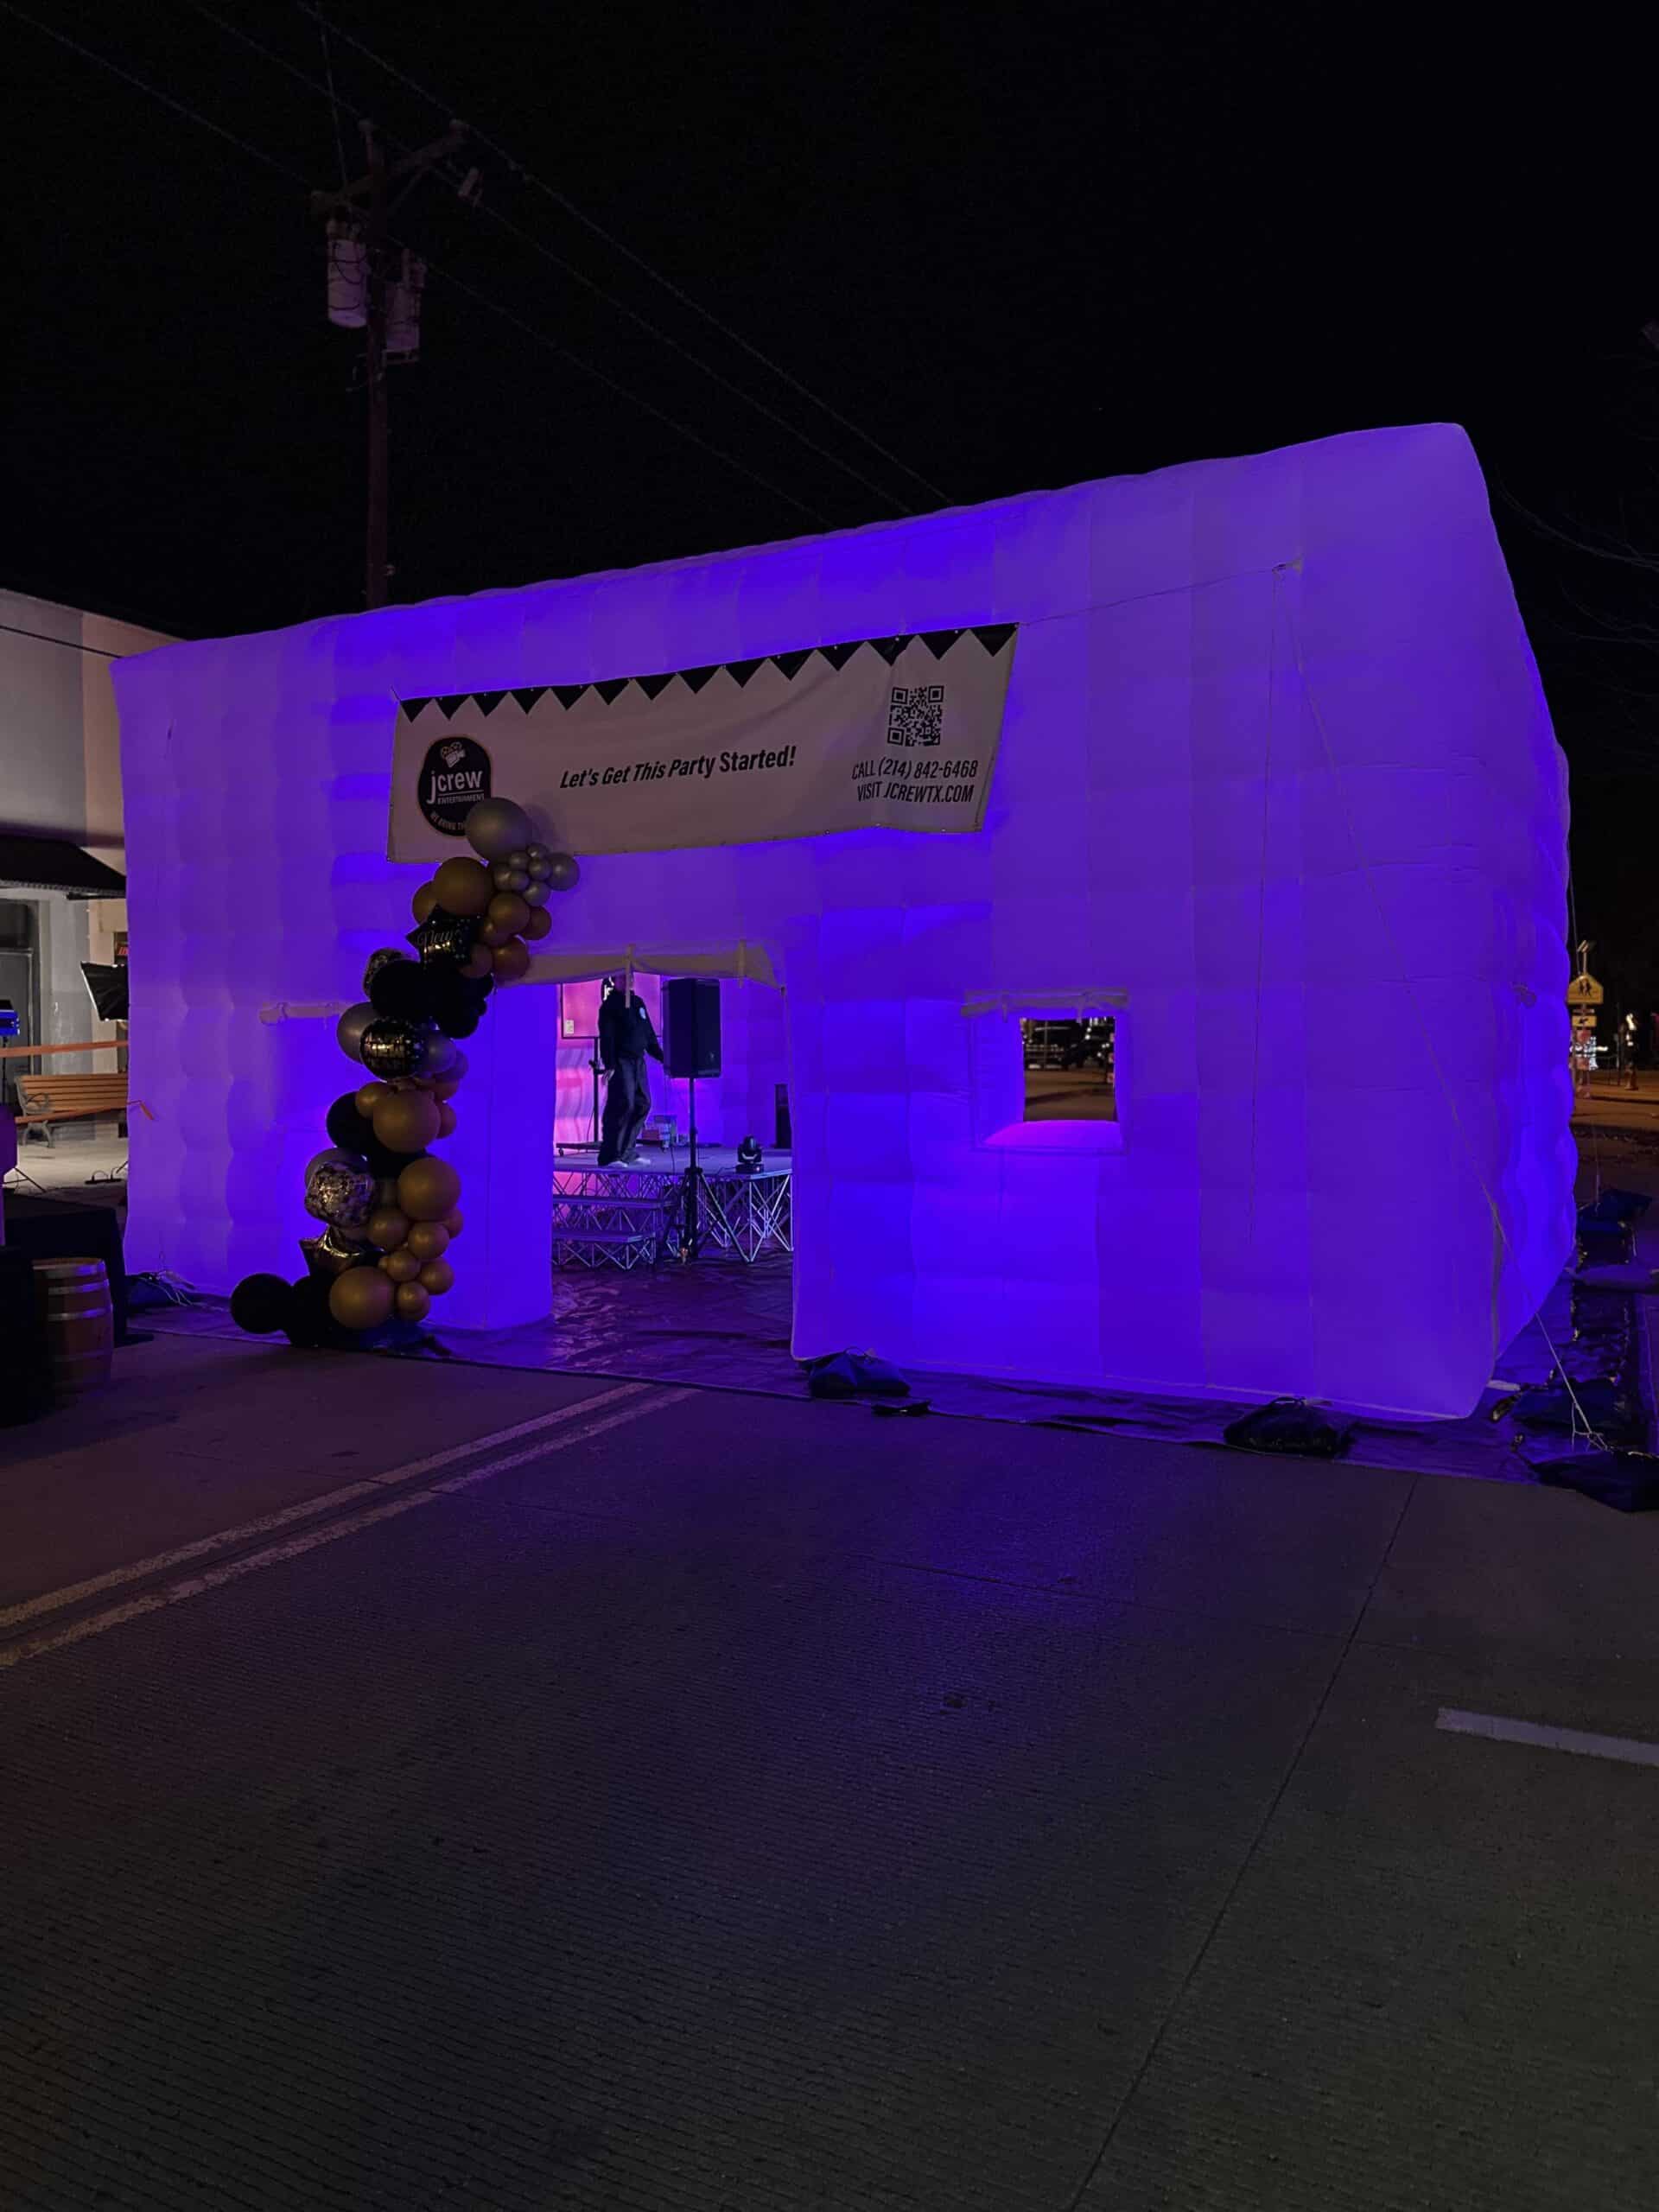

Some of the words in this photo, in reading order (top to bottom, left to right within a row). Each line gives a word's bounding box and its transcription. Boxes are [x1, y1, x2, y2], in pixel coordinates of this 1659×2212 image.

[560, 769, 598, 788] Let's
[602, 766, 631, 785] Get
[632, 761, 665, 781] This
[668, 755, 715, 779] Party
[720, 746, 796, 772] Started!
[852, 760, 875, 779] CALL
[878, 757, 912, 779] (214)
[914, 760, 978, 779] 842-6468
[426, 770, 484, 805] jcrew
[857, 781, 882, 801] VISIT
[883, 782, 974, 802] JCREWTX.COM
